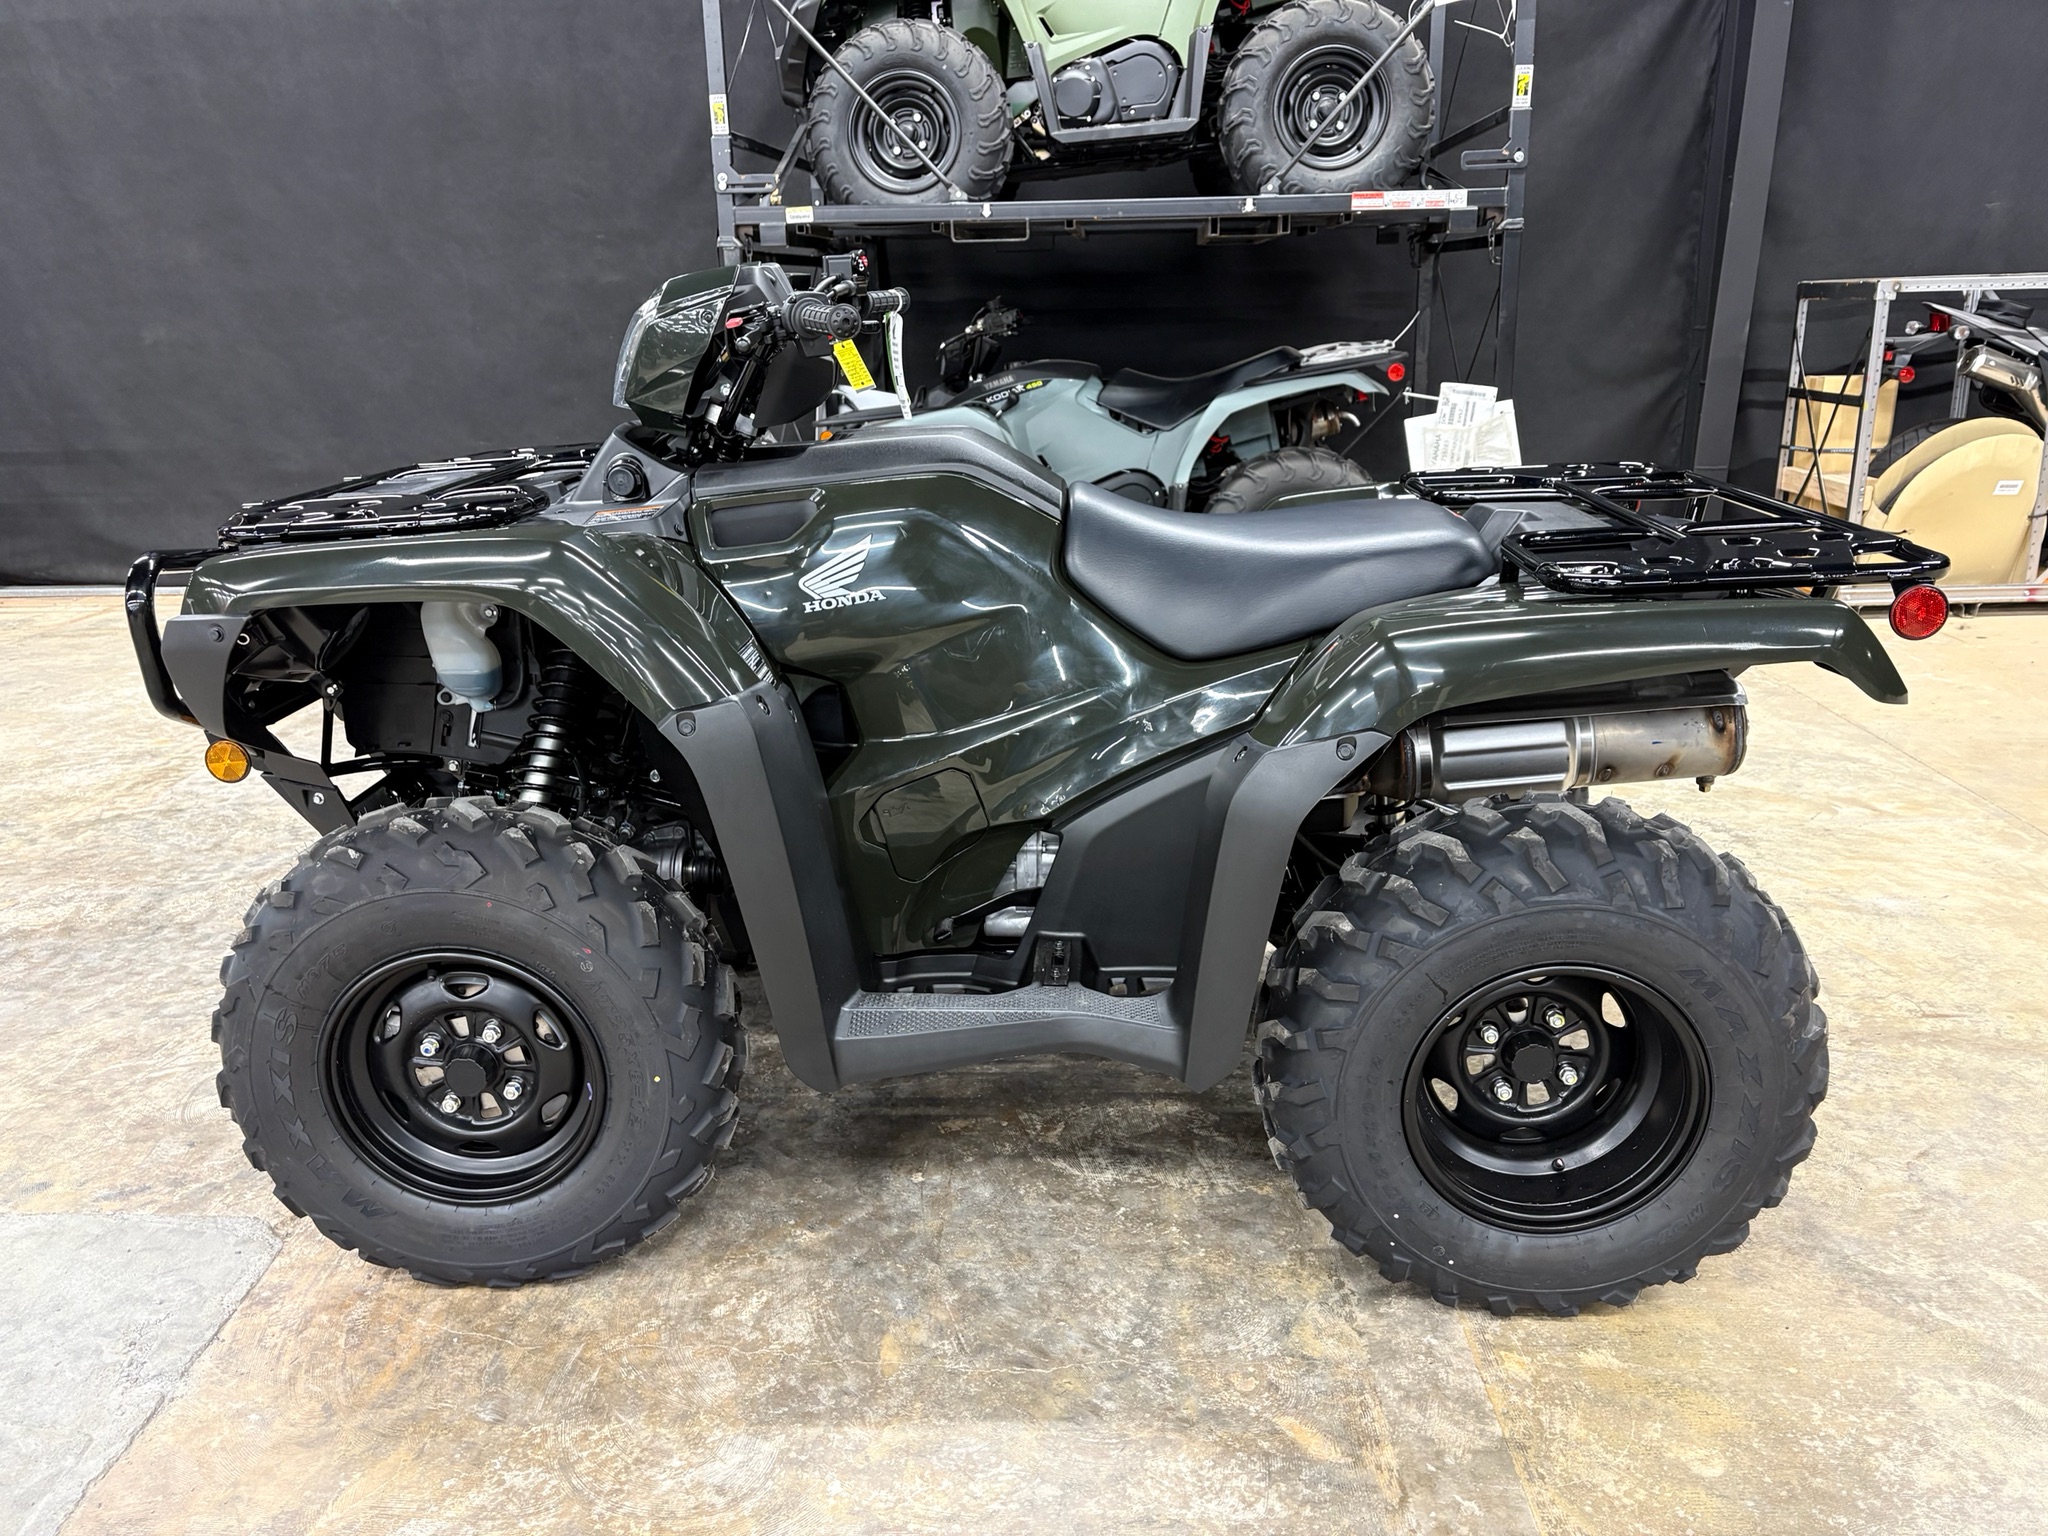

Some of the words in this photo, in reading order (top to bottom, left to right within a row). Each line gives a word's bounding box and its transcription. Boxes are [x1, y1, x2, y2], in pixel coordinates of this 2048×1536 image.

[984, 375, 1014, 390] YAMAHA
[803, 590, 886, 613] HONDA
[296, 943, 346, 999] M975
[1675, 968, 1764, 1192] MAXXIS
[269, 1007, 397, 1219] MAXXIS
